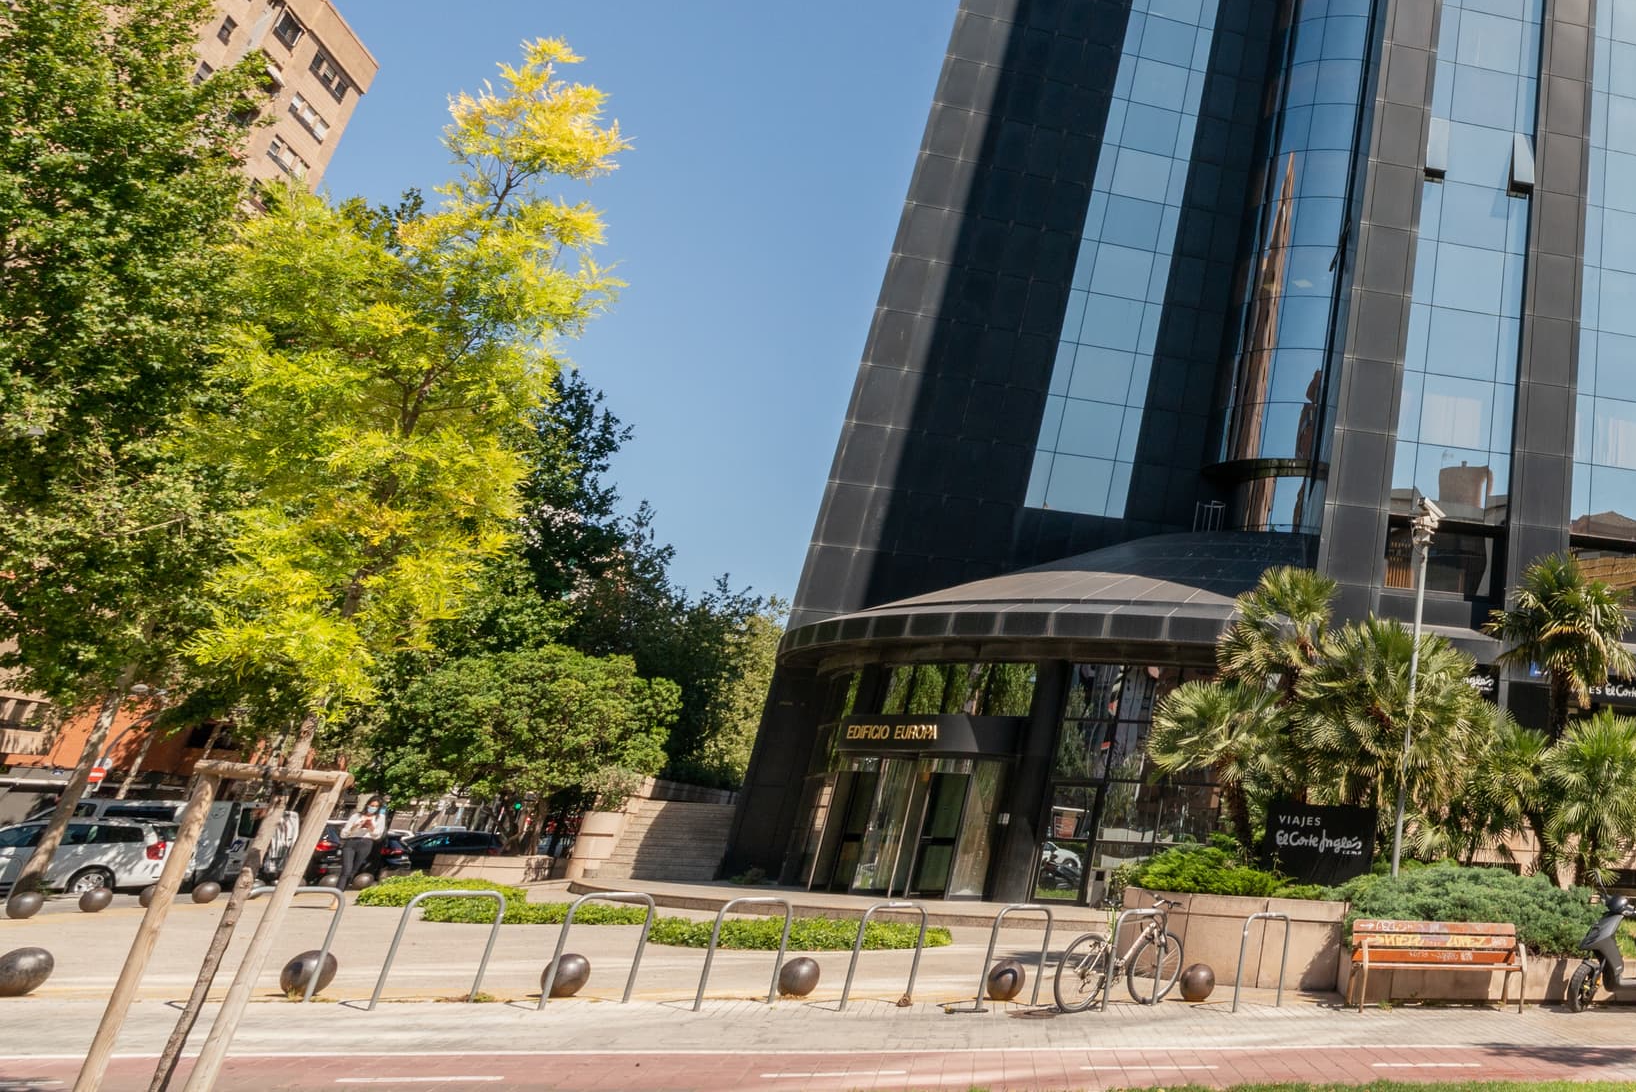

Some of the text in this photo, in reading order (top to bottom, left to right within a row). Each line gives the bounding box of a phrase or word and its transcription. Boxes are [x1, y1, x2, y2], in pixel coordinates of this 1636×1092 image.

[846, 724, 938, 740] EDIFICIO EUROPA
[1279, 815, 1321, 827] VIAJES
[1276, 829, 1363, 854] El Corte Inglés
